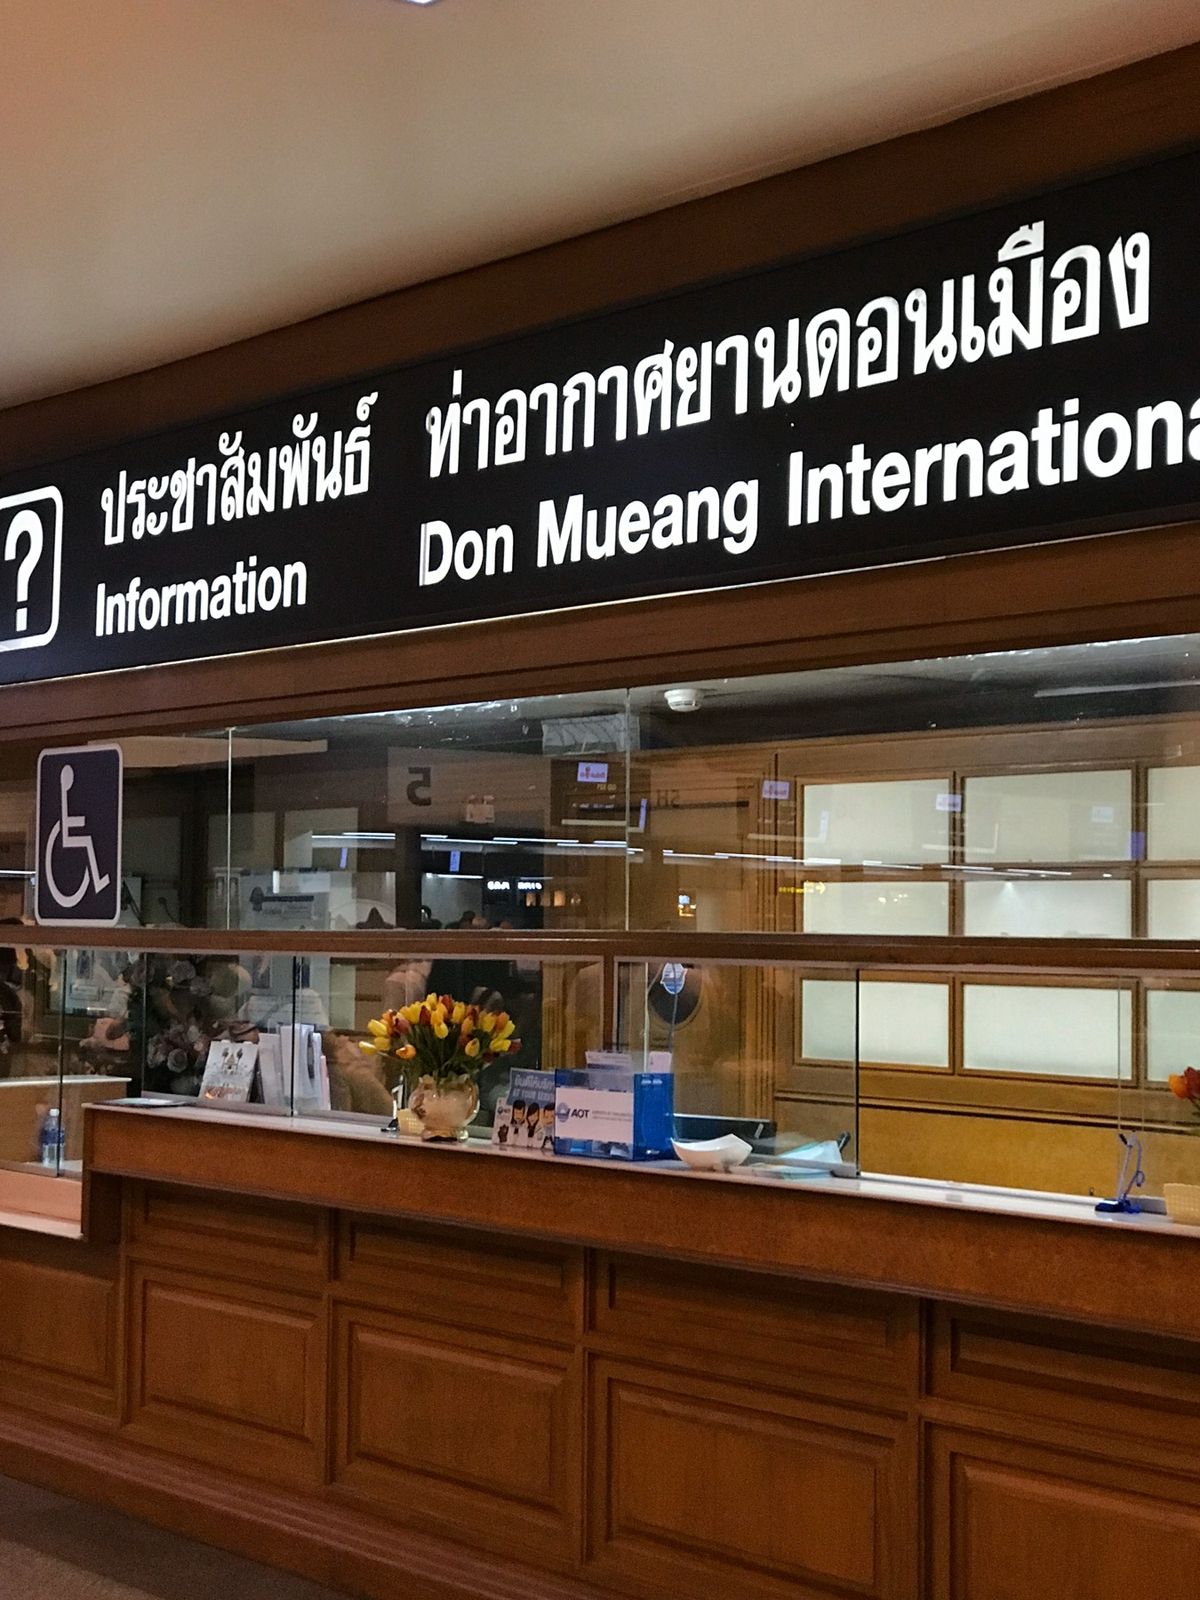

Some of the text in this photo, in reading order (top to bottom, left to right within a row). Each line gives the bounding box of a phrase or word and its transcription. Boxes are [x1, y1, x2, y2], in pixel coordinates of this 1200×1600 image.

[100, 221, 1150, 546] ประชาสัมพันธ์ ท่าอากาศยานดอนเมือง
[95, 397, 1200, 637] Information Don Mueang Internation
[571, 1108, 590, 1119] AOT
